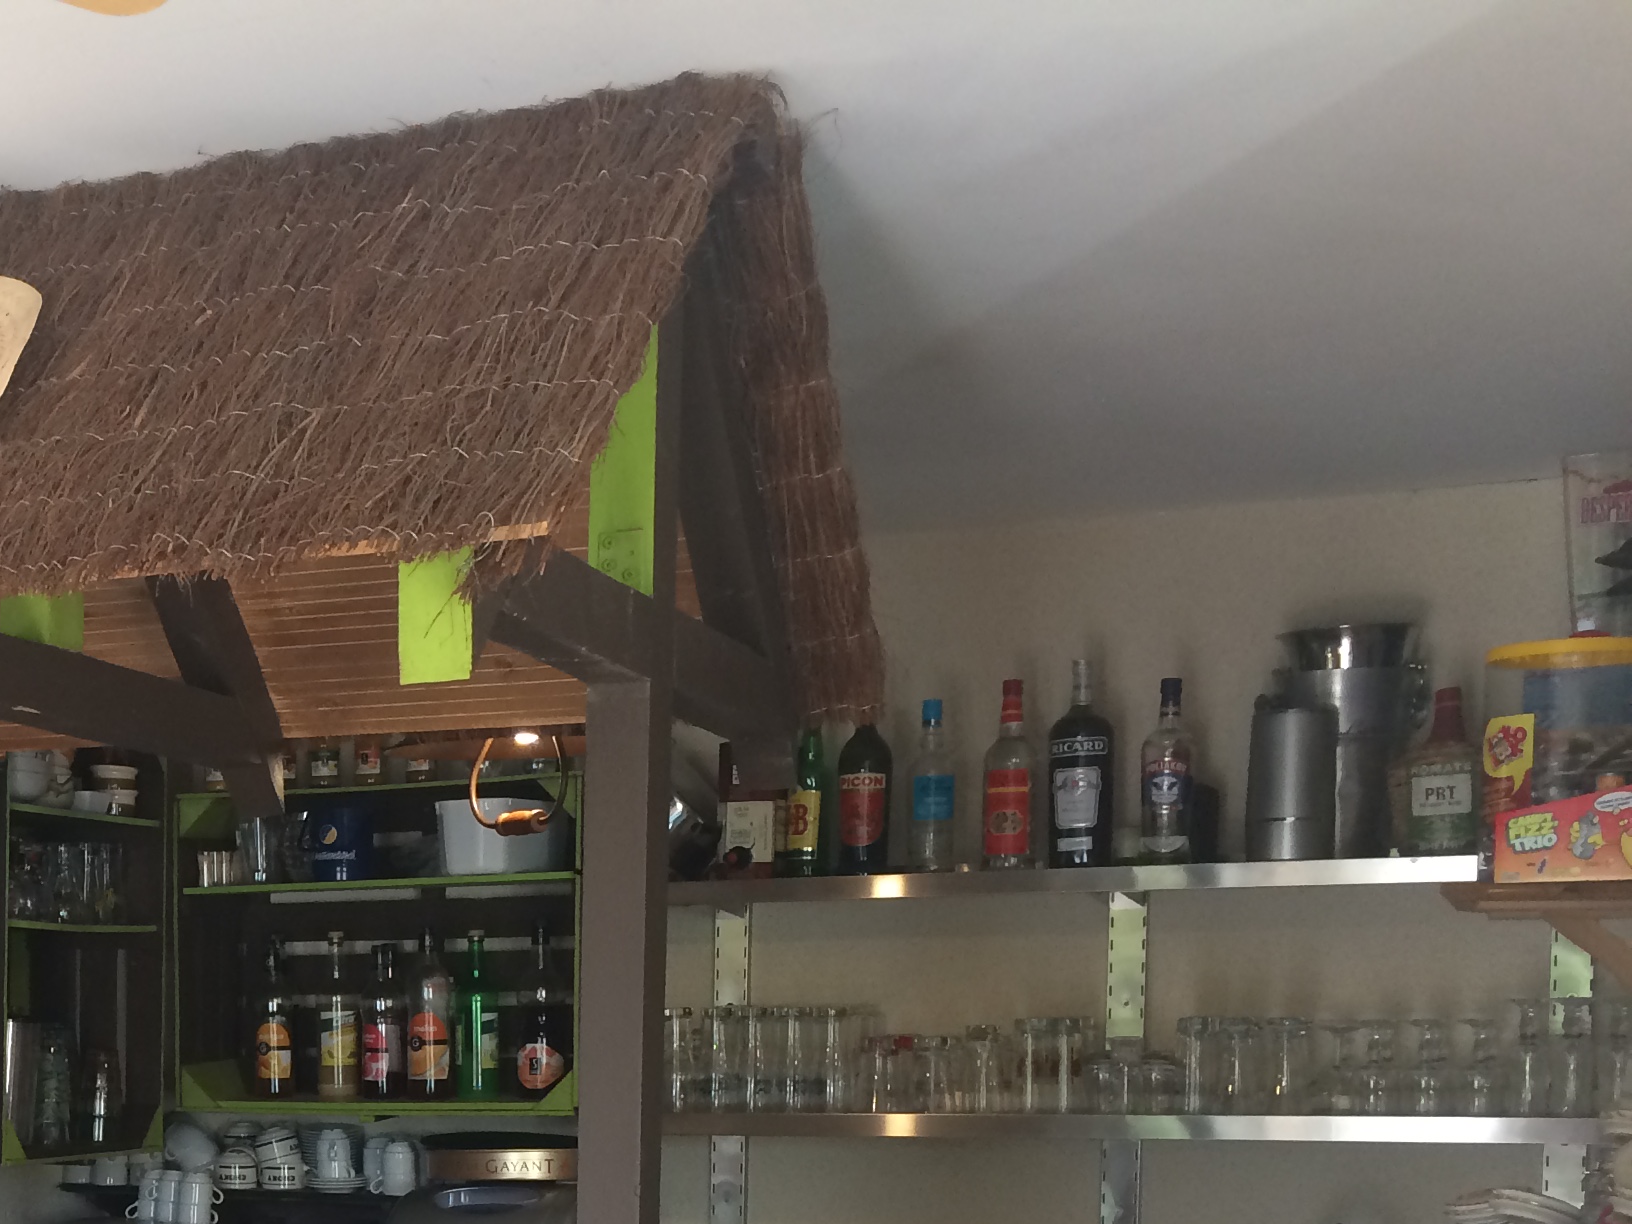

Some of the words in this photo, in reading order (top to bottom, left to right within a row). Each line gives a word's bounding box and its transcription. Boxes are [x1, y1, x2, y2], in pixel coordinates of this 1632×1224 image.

[1052, 741, 1104, 754] RICARD
[840, 776, 884, 788] PICON
[1511, 834, 1558, 850] TRIO
